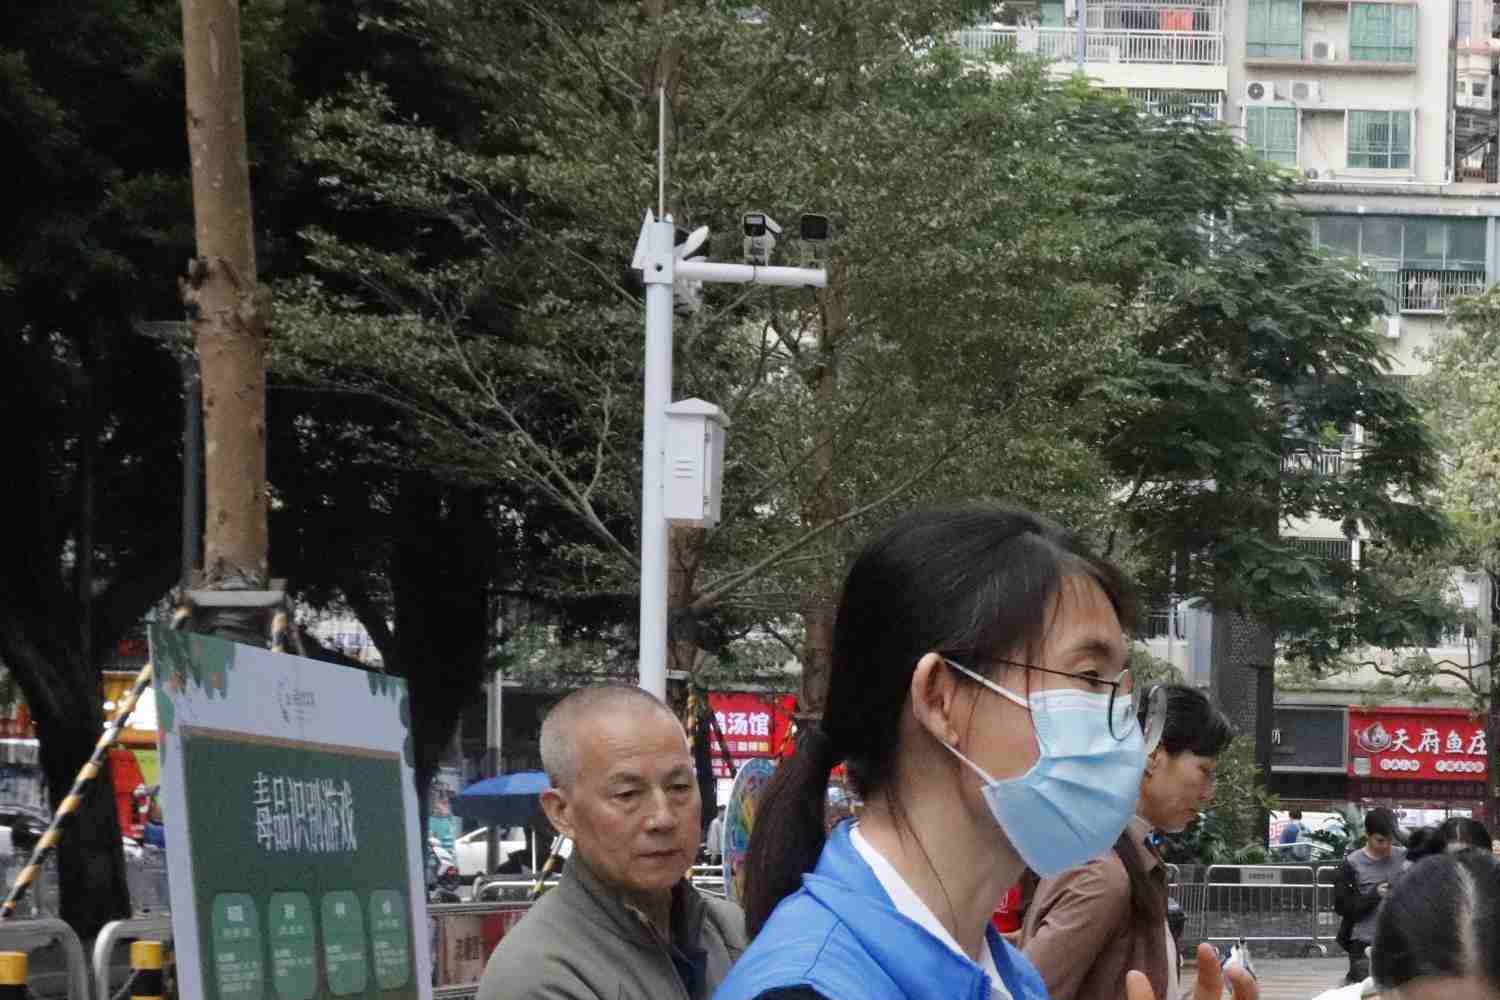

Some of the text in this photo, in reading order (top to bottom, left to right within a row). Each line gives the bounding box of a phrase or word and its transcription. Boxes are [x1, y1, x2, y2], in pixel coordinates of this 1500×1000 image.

[1391, 728, 1487, 755] 天府鱼庄
[252, 771, 358, 851] 毒品识别游戏
